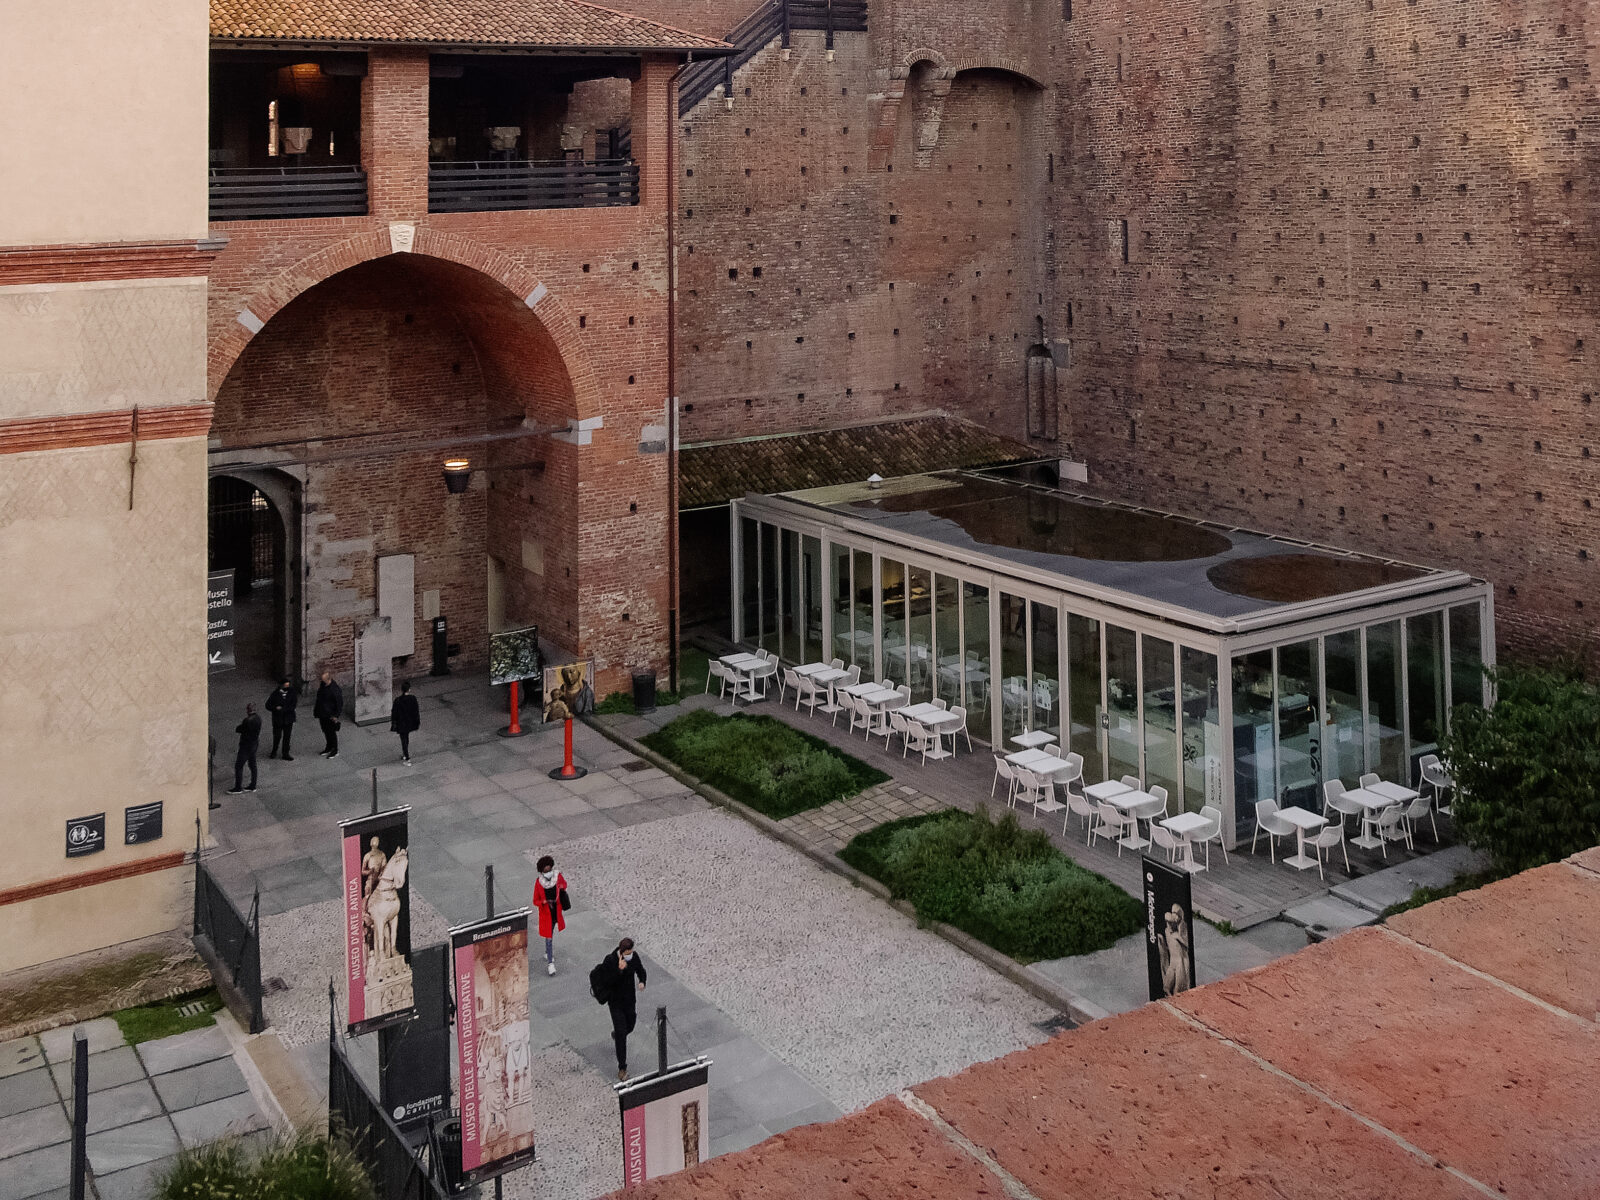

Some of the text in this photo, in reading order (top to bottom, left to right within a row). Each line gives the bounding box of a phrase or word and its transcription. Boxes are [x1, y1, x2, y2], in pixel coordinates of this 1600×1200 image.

[207, 598, 232, 609] stello
[349, 877, 361, 980] MUSEO D'ARTE ANTICA
[472, 926, 512, 941] Bramantino
[1147, 890, 1156, 944] Michelangelo
[460, 972, 477, 1141] MUSEO DELLE ARTI DECORATIVE
[406, 1094, 442, 1109] fondazione
